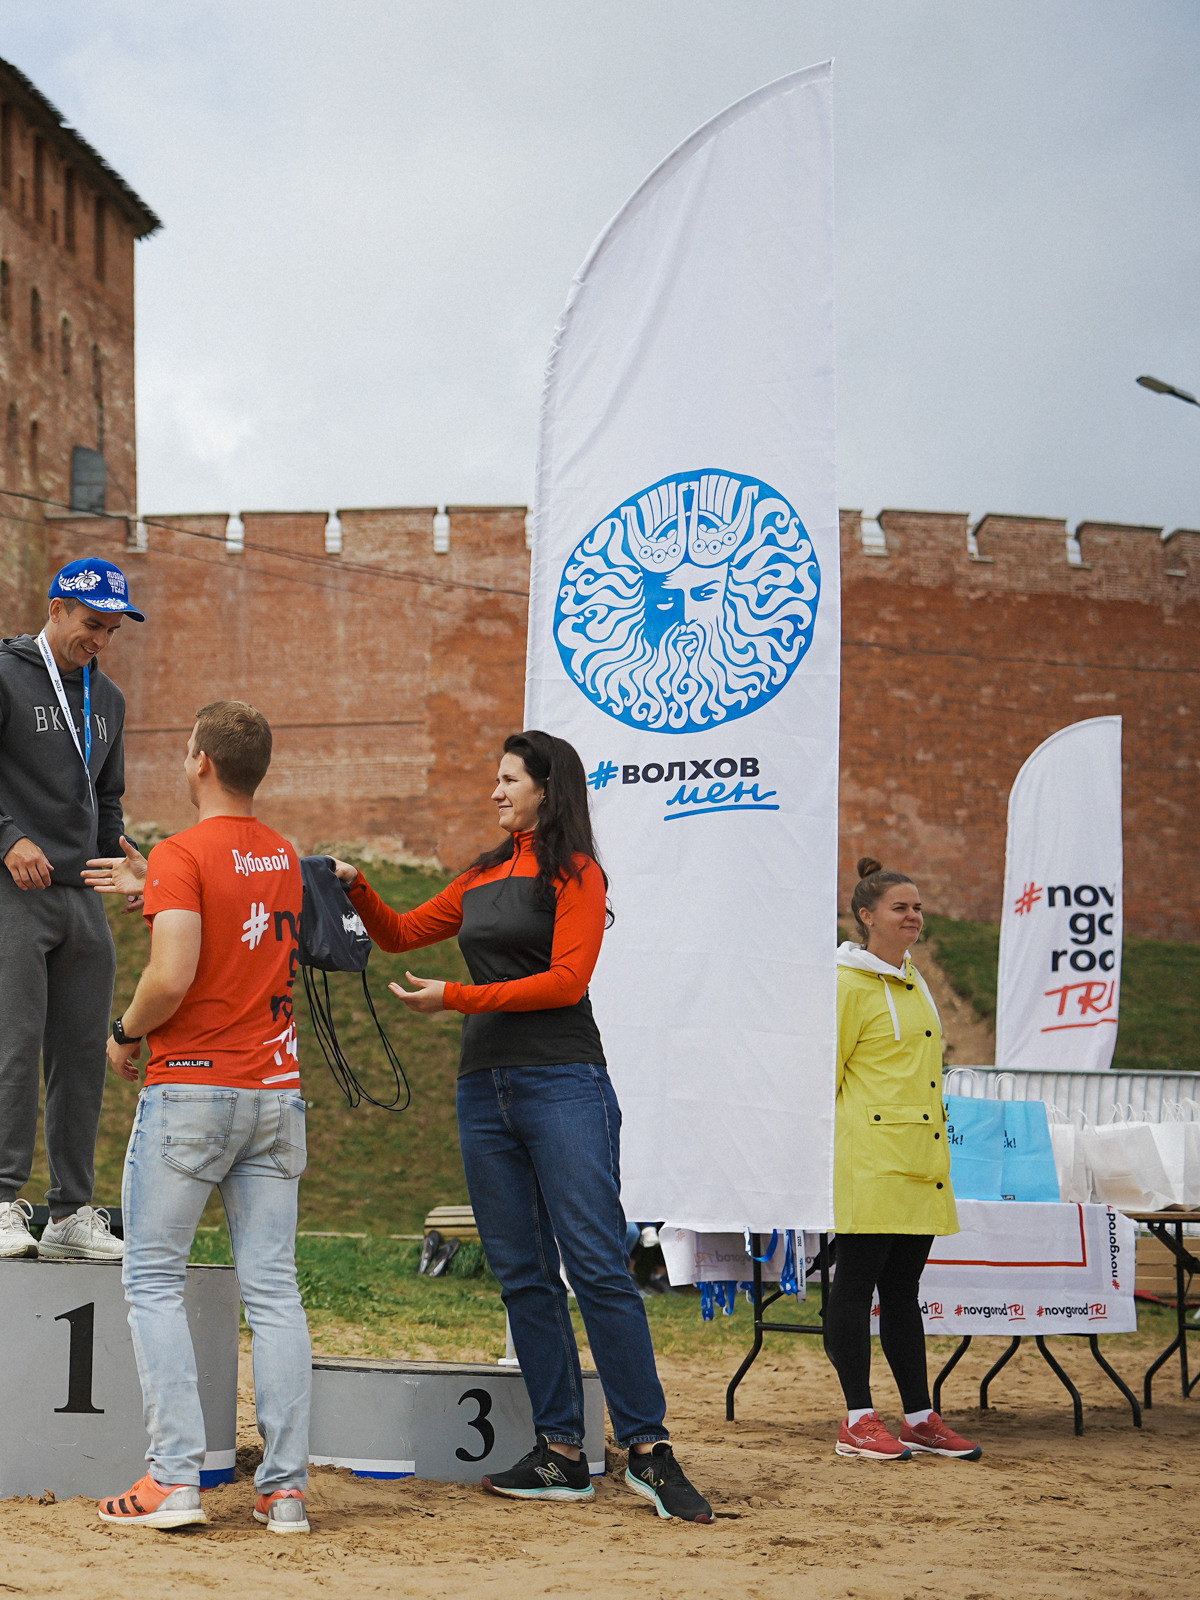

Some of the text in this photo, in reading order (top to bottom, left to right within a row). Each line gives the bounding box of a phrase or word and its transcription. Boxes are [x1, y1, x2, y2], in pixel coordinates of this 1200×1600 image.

[33, 705, 108, 744] BKN
[586, 757, 760, 791] #ВОЛХОВ
[231, 847, 290, 877] Дубовой
[54, 1302, 105, 1414] 1
[455, 1388, 495, 1462] 3
